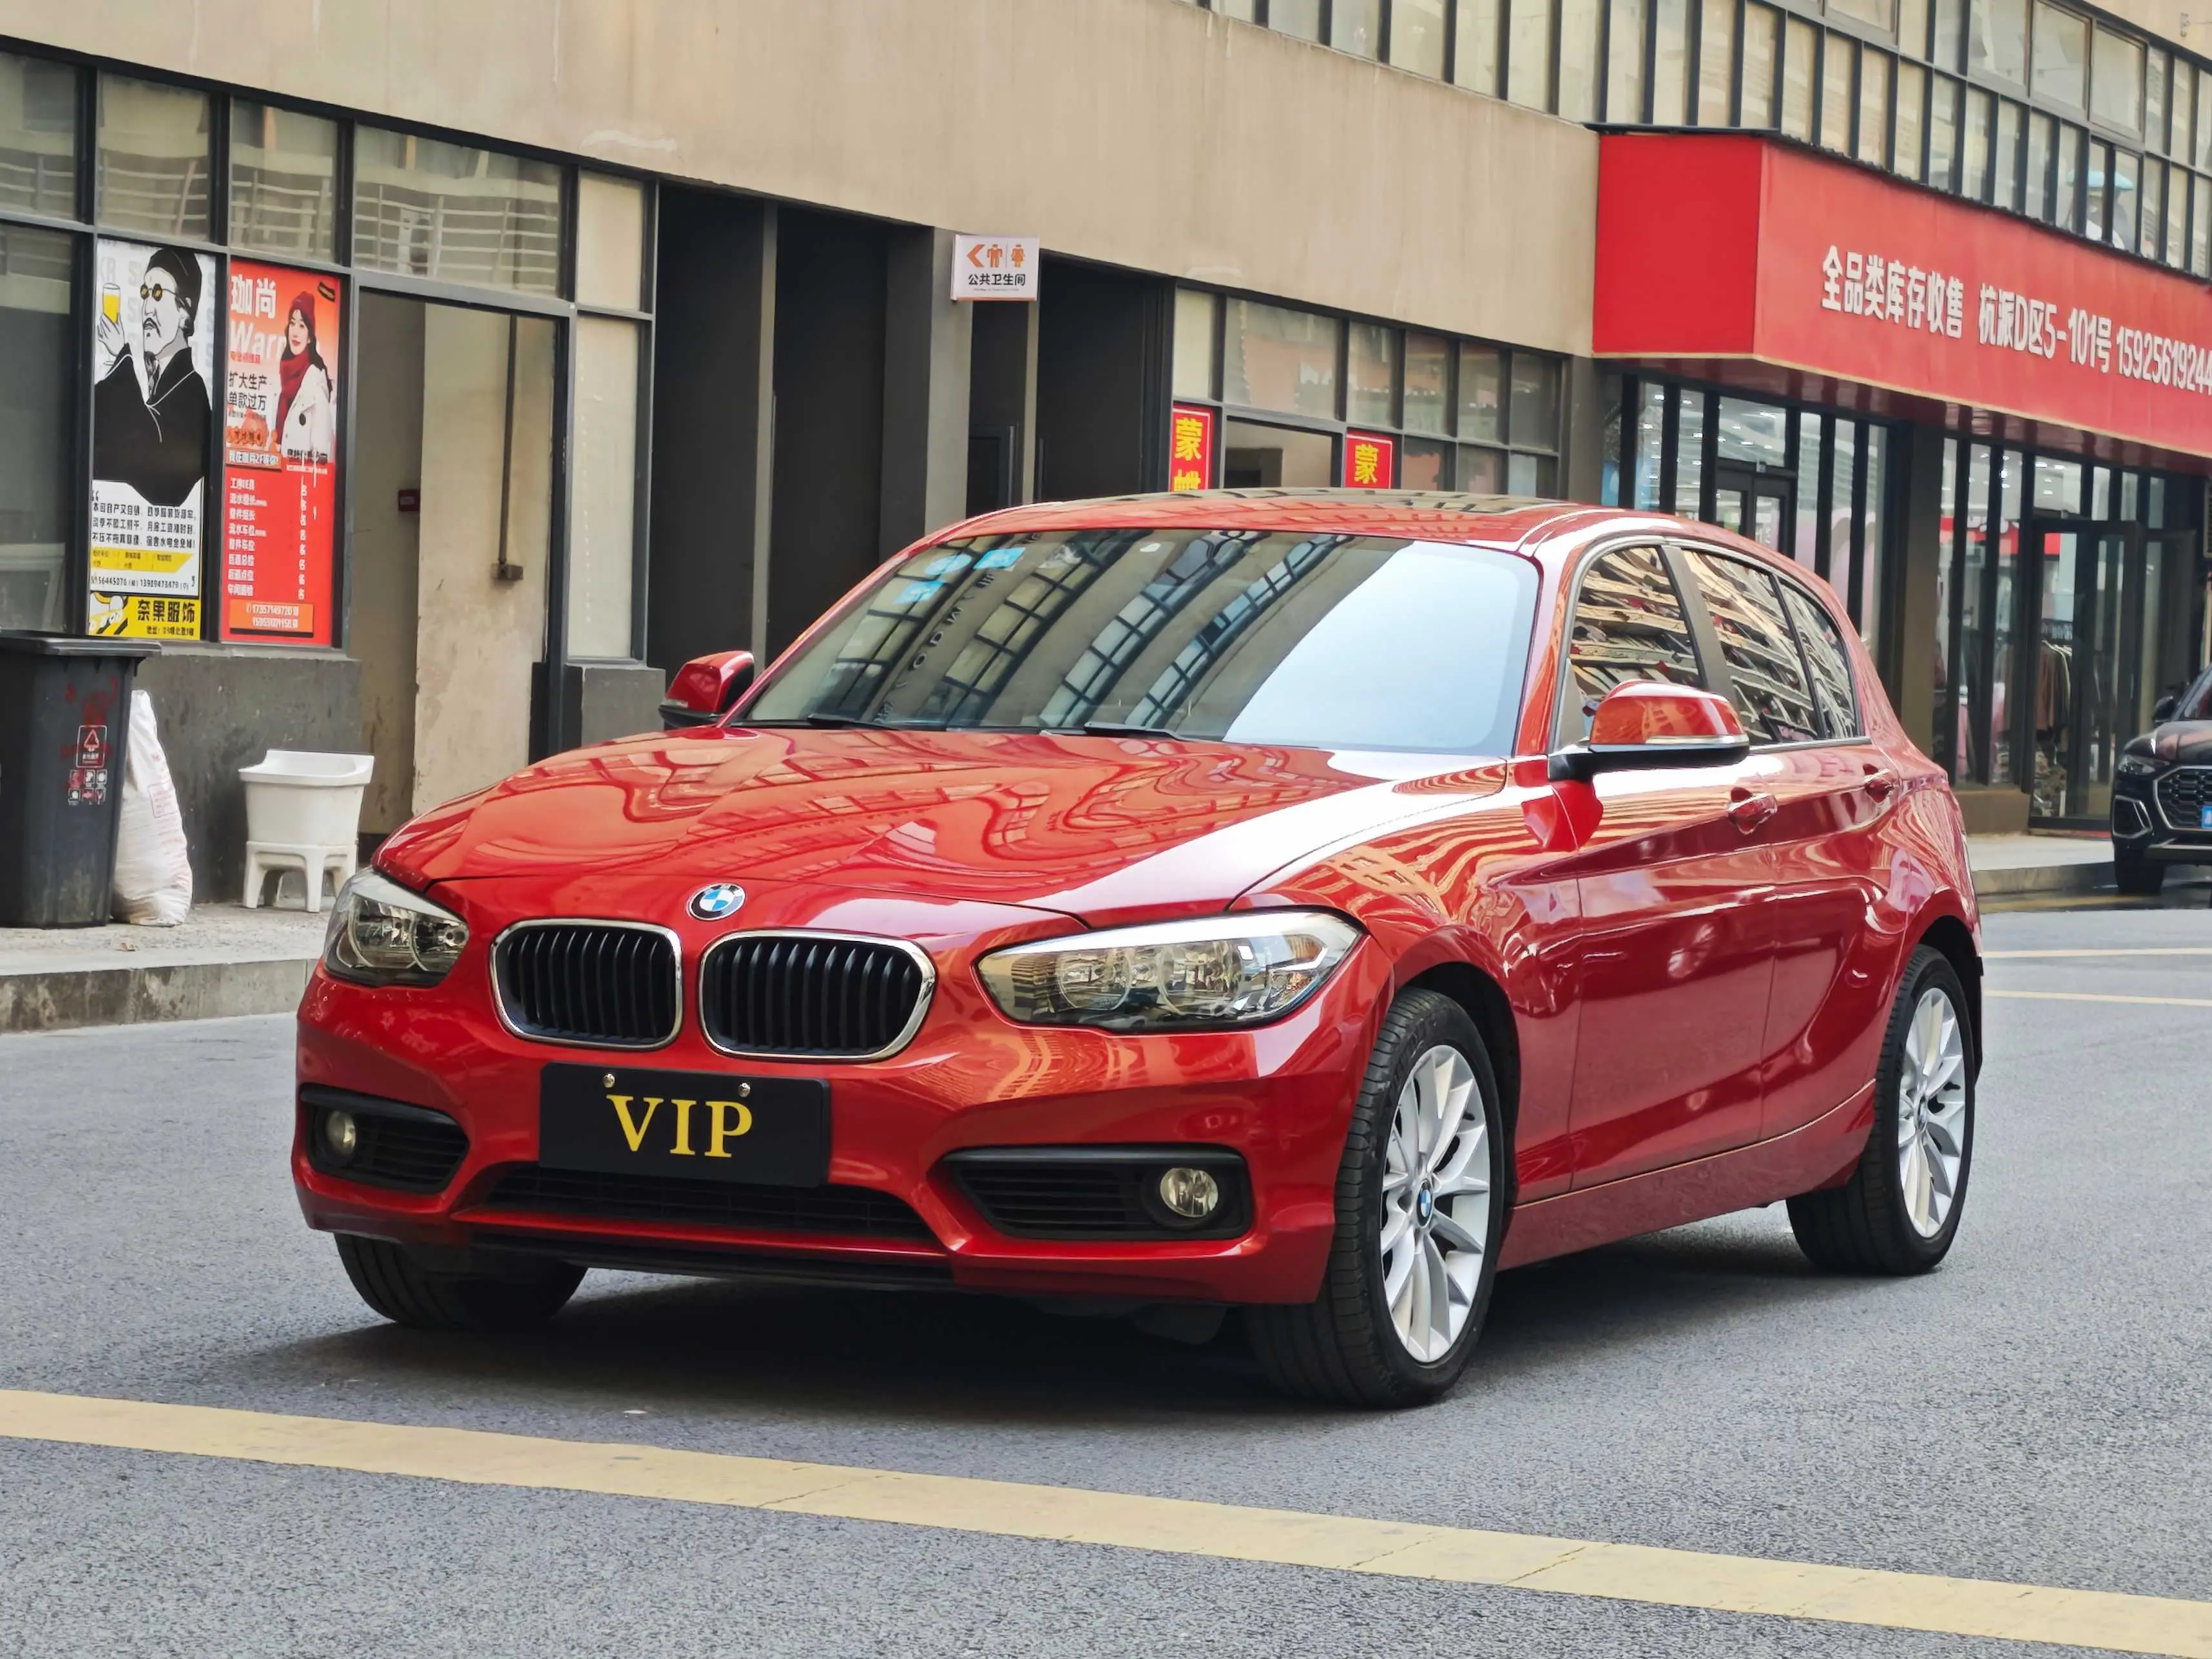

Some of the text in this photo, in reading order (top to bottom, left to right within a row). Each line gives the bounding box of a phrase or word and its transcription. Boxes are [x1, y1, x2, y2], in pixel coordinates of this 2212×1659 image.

[968, 273, 1026, 286] 公共卫生间
[1822, 245, 1964, 338] 全品类库存收售
[2116, 325, 2212, 395] 15925619244
[229, 370, 267, 392] 扩大生产
[229, 391, 267, 411] 单款过万
[1354, 443, 1378, 484] 蒙
[606, 1094, 753, 1158] VIP
